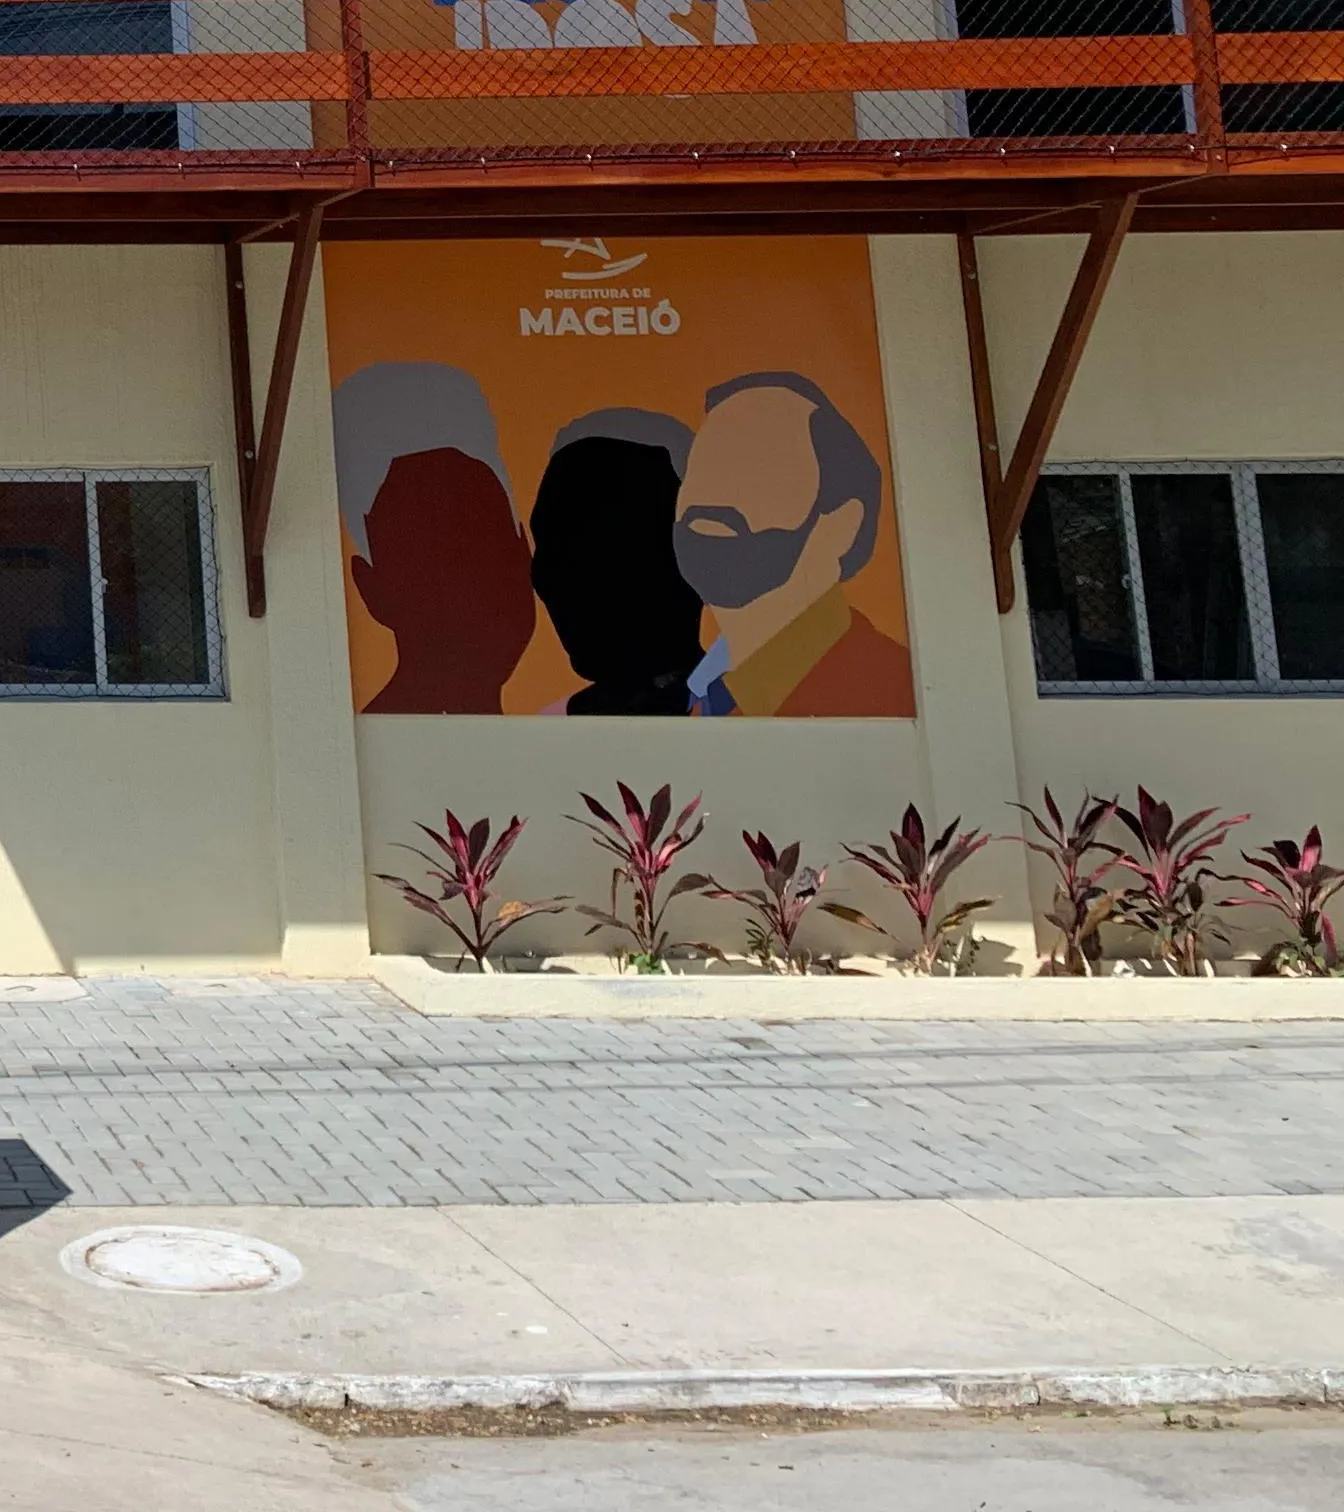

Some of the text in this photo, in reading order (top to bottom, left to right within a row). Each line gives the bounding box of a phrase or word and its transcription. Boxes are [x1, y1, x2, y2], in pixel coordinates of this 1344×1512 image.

[544, 287, 652, 299] PREFEITURA DE
[519, 299, 681, 336] MACEIÓ
